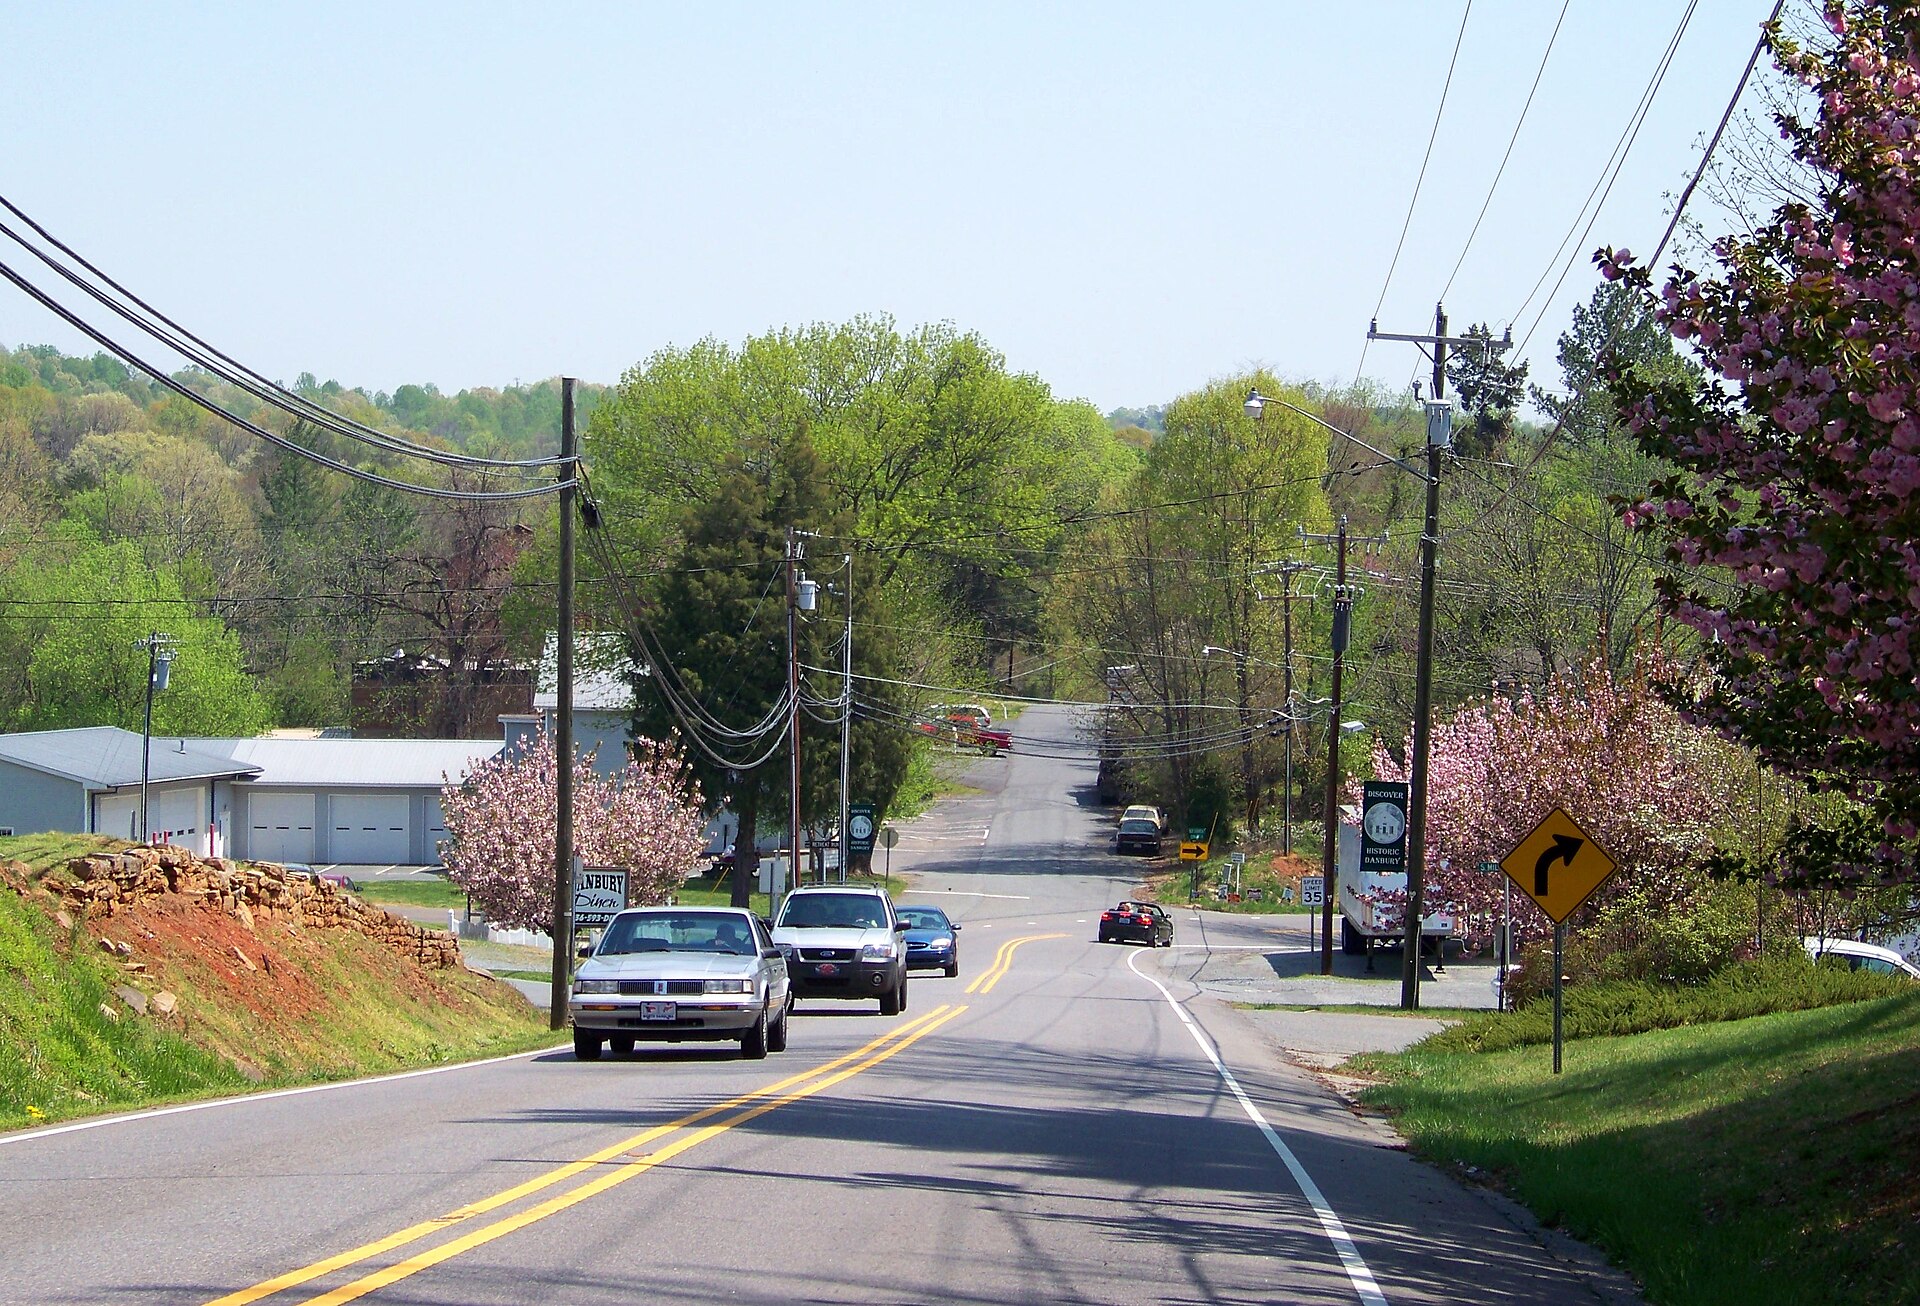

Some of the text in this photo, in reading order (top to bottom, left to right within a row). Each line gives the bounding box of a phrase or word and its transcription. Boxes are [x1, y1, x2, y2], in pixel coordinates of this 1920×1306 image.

[1367, 790, 1404, 799] DISCOVER
[1366, 847, 1400, 855] HISTORIC
[1364, 857, 1400, 865] DANBURY
[1487, 863, 1499, 871] MIL
[576, 874, 624, 894] ANBURY
[575, 893, 619, 908] Diner
[1304, 892, 1322, 902] 35
[575, 914, 614, 922] 36-593-DI
